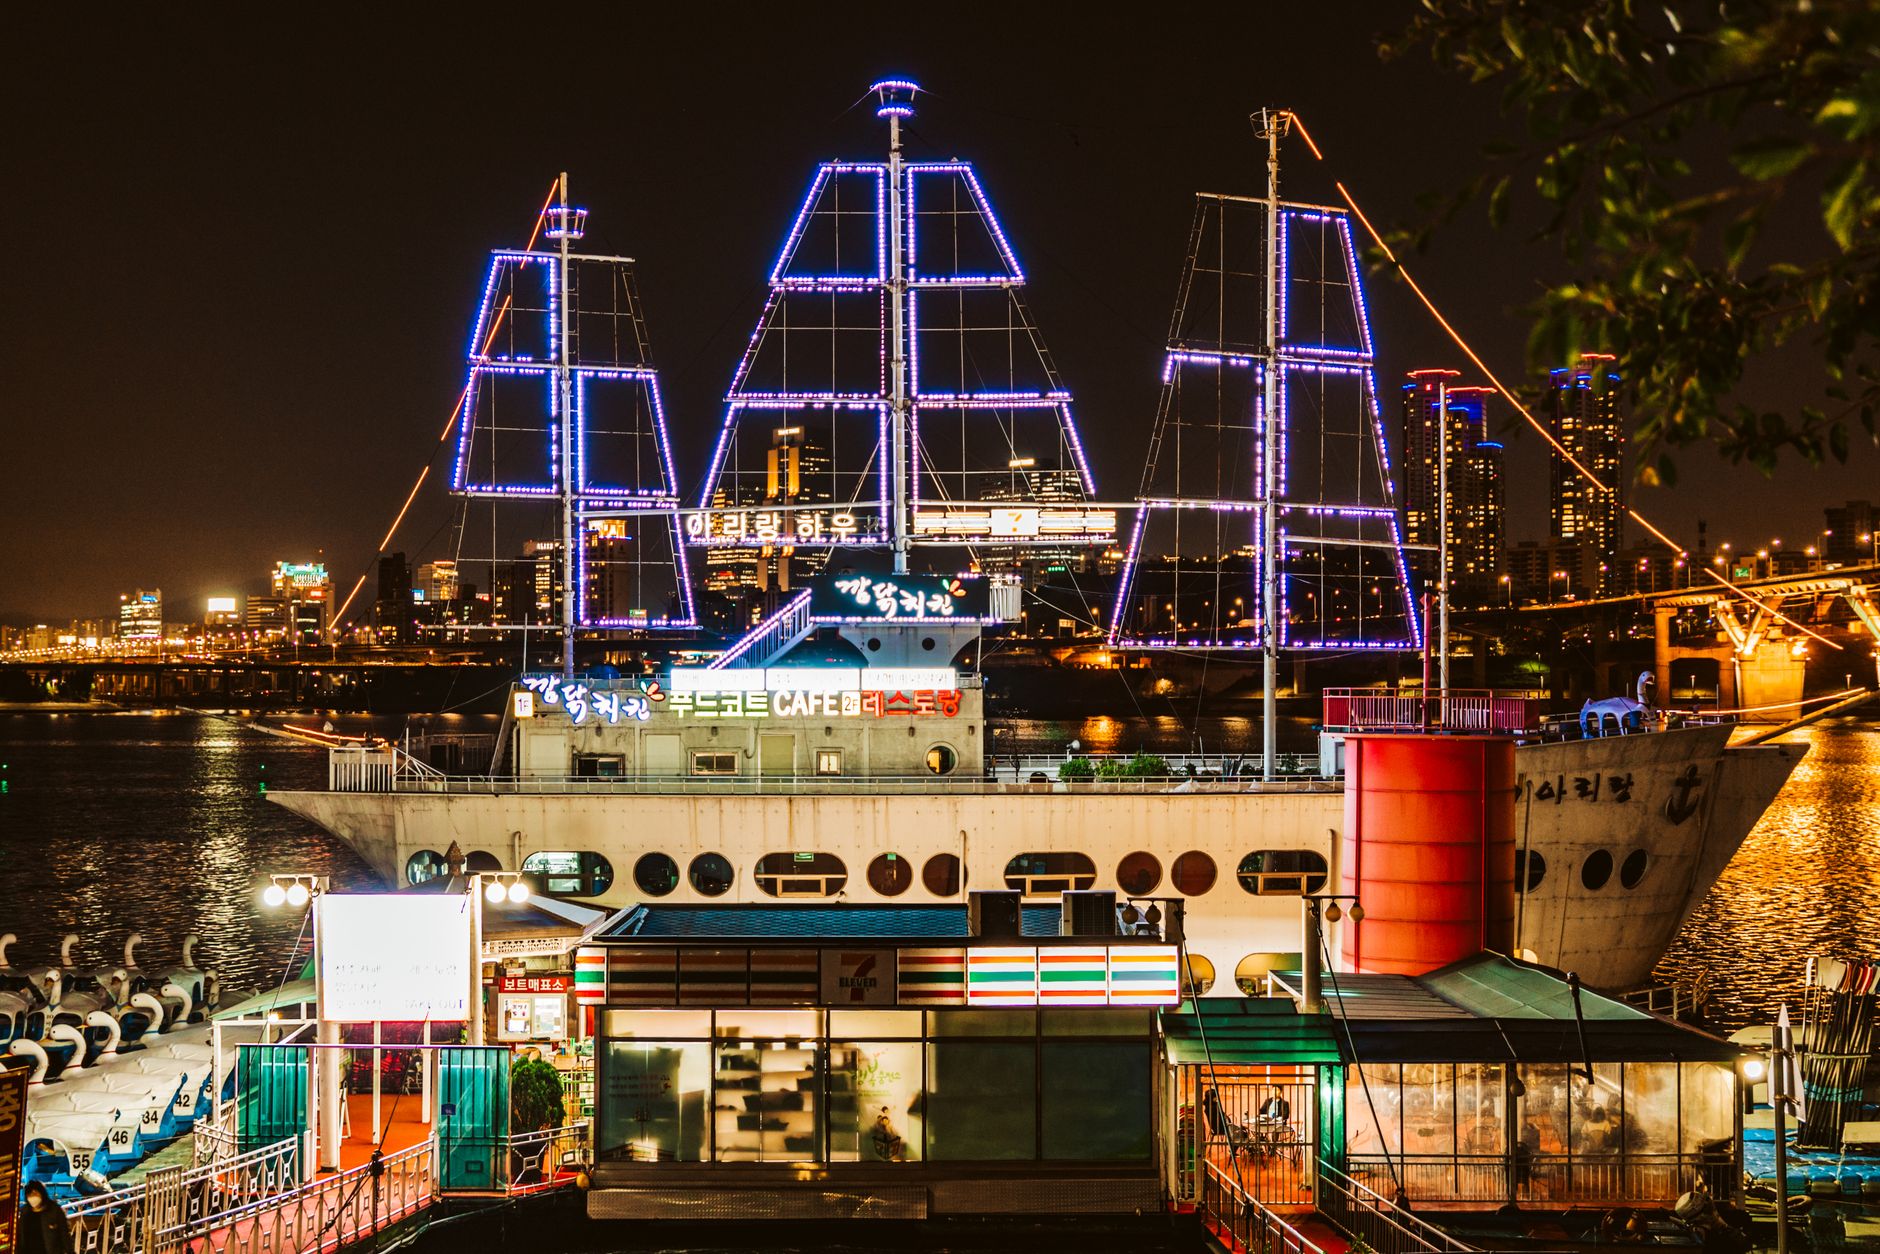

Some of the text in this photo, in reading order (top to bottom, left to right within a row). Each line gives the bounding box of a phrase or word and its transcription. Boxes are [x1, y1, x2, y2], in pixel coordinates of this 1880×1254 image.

[686, 511, 782, 542] 아리랑
[669, 690, 769, 718] 푸드코트
[773, 689, 840, 717] CAFE
[843, 695, 859, 712] 2F
[861, 689, 963, 718] 레스토랑
[503, 978, 564, 992] 보트매표소
[174, 1094, 191, 1108] 42
[142, 1110, 159, 1125] 34
[111, 1130, 129, 1145] 46
[72, 1153, 91, 1170] 55
